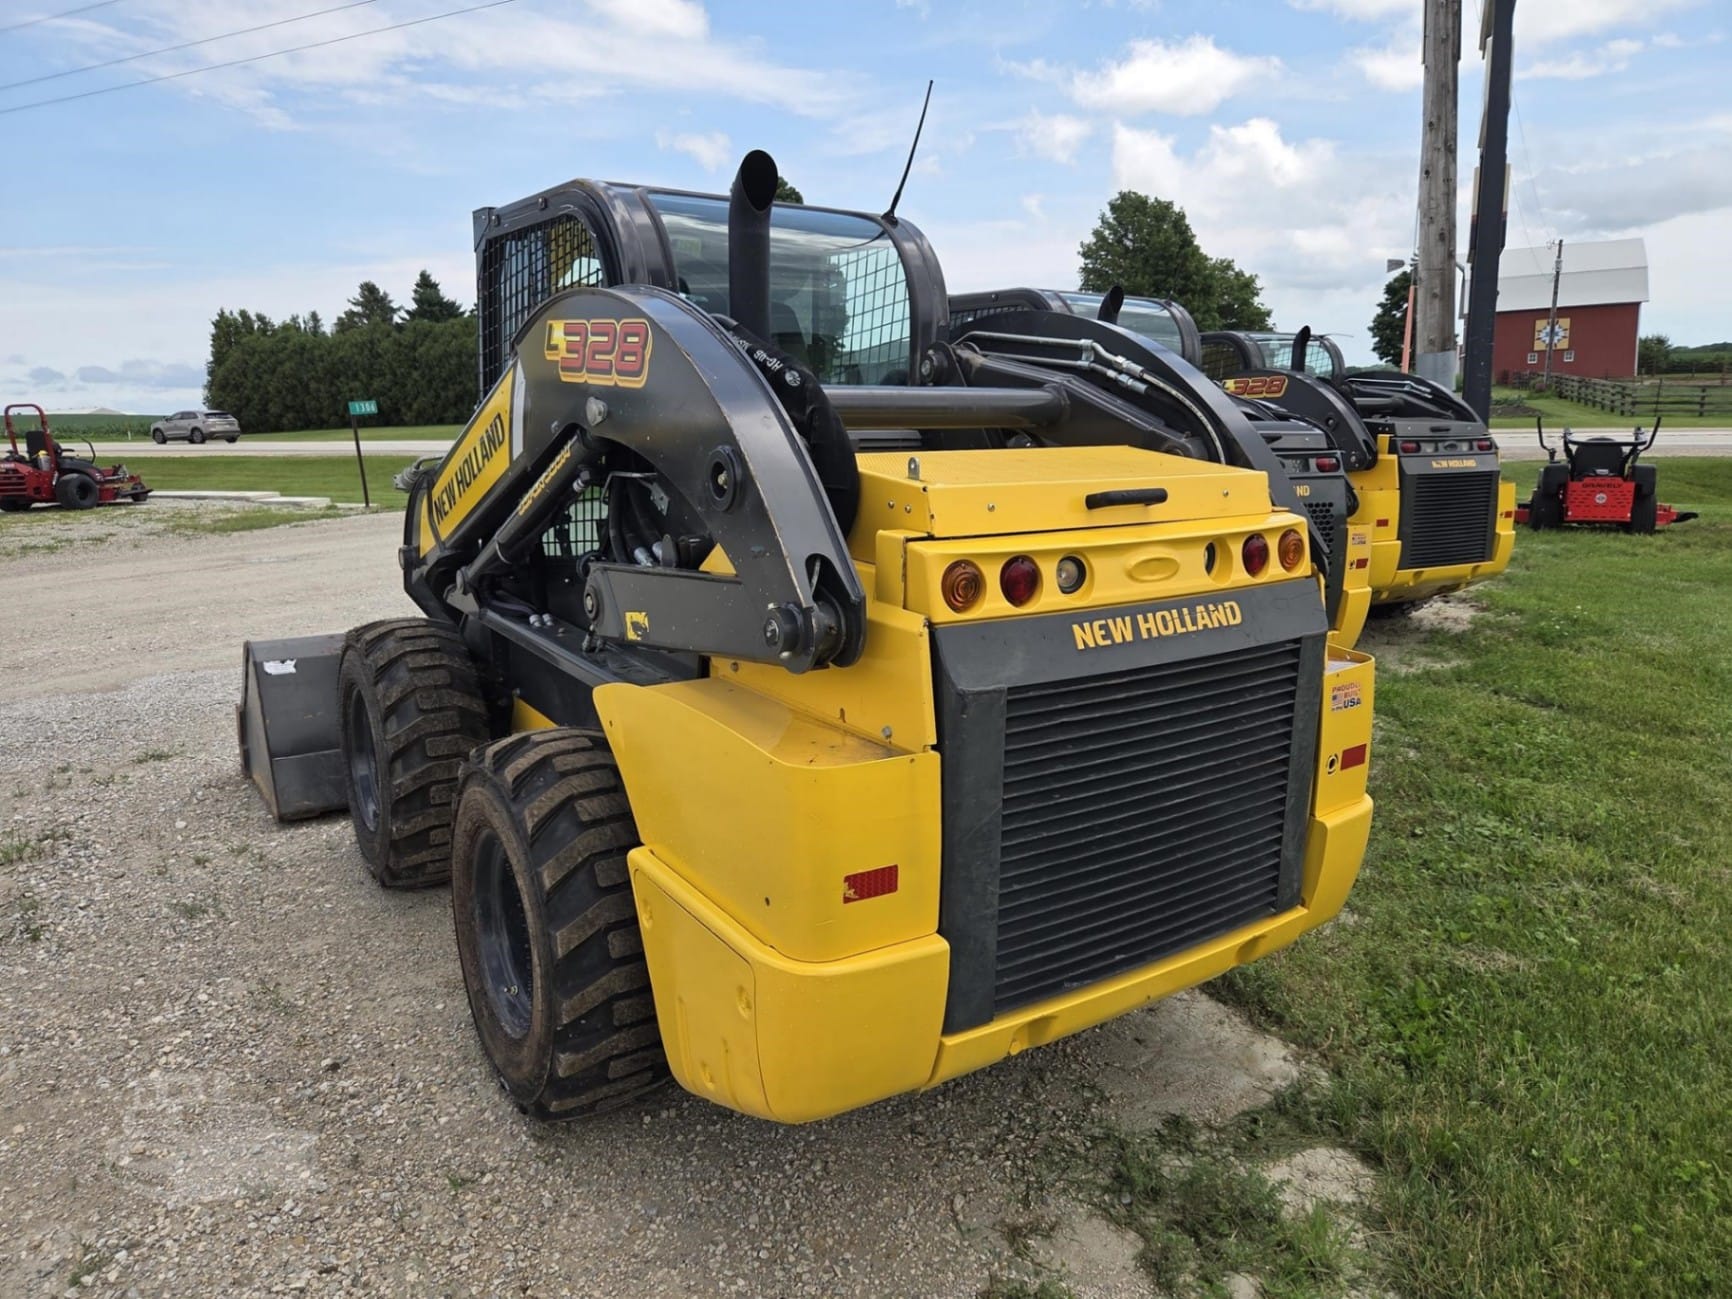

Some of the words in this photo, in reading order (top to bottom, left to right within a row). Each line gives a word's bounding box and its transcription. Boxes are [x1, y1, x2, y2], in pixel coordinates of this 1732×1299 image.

[545, 320, 651, 386] L328
[433, 477, 457, 526] NEW
[455, 412, 505, 499] HOLLAND
[1071, 615, 1134, 650] NEW
[1136, 600, 1243, 640] HOLLAND
[1343, 697, 1361, 708] USA
